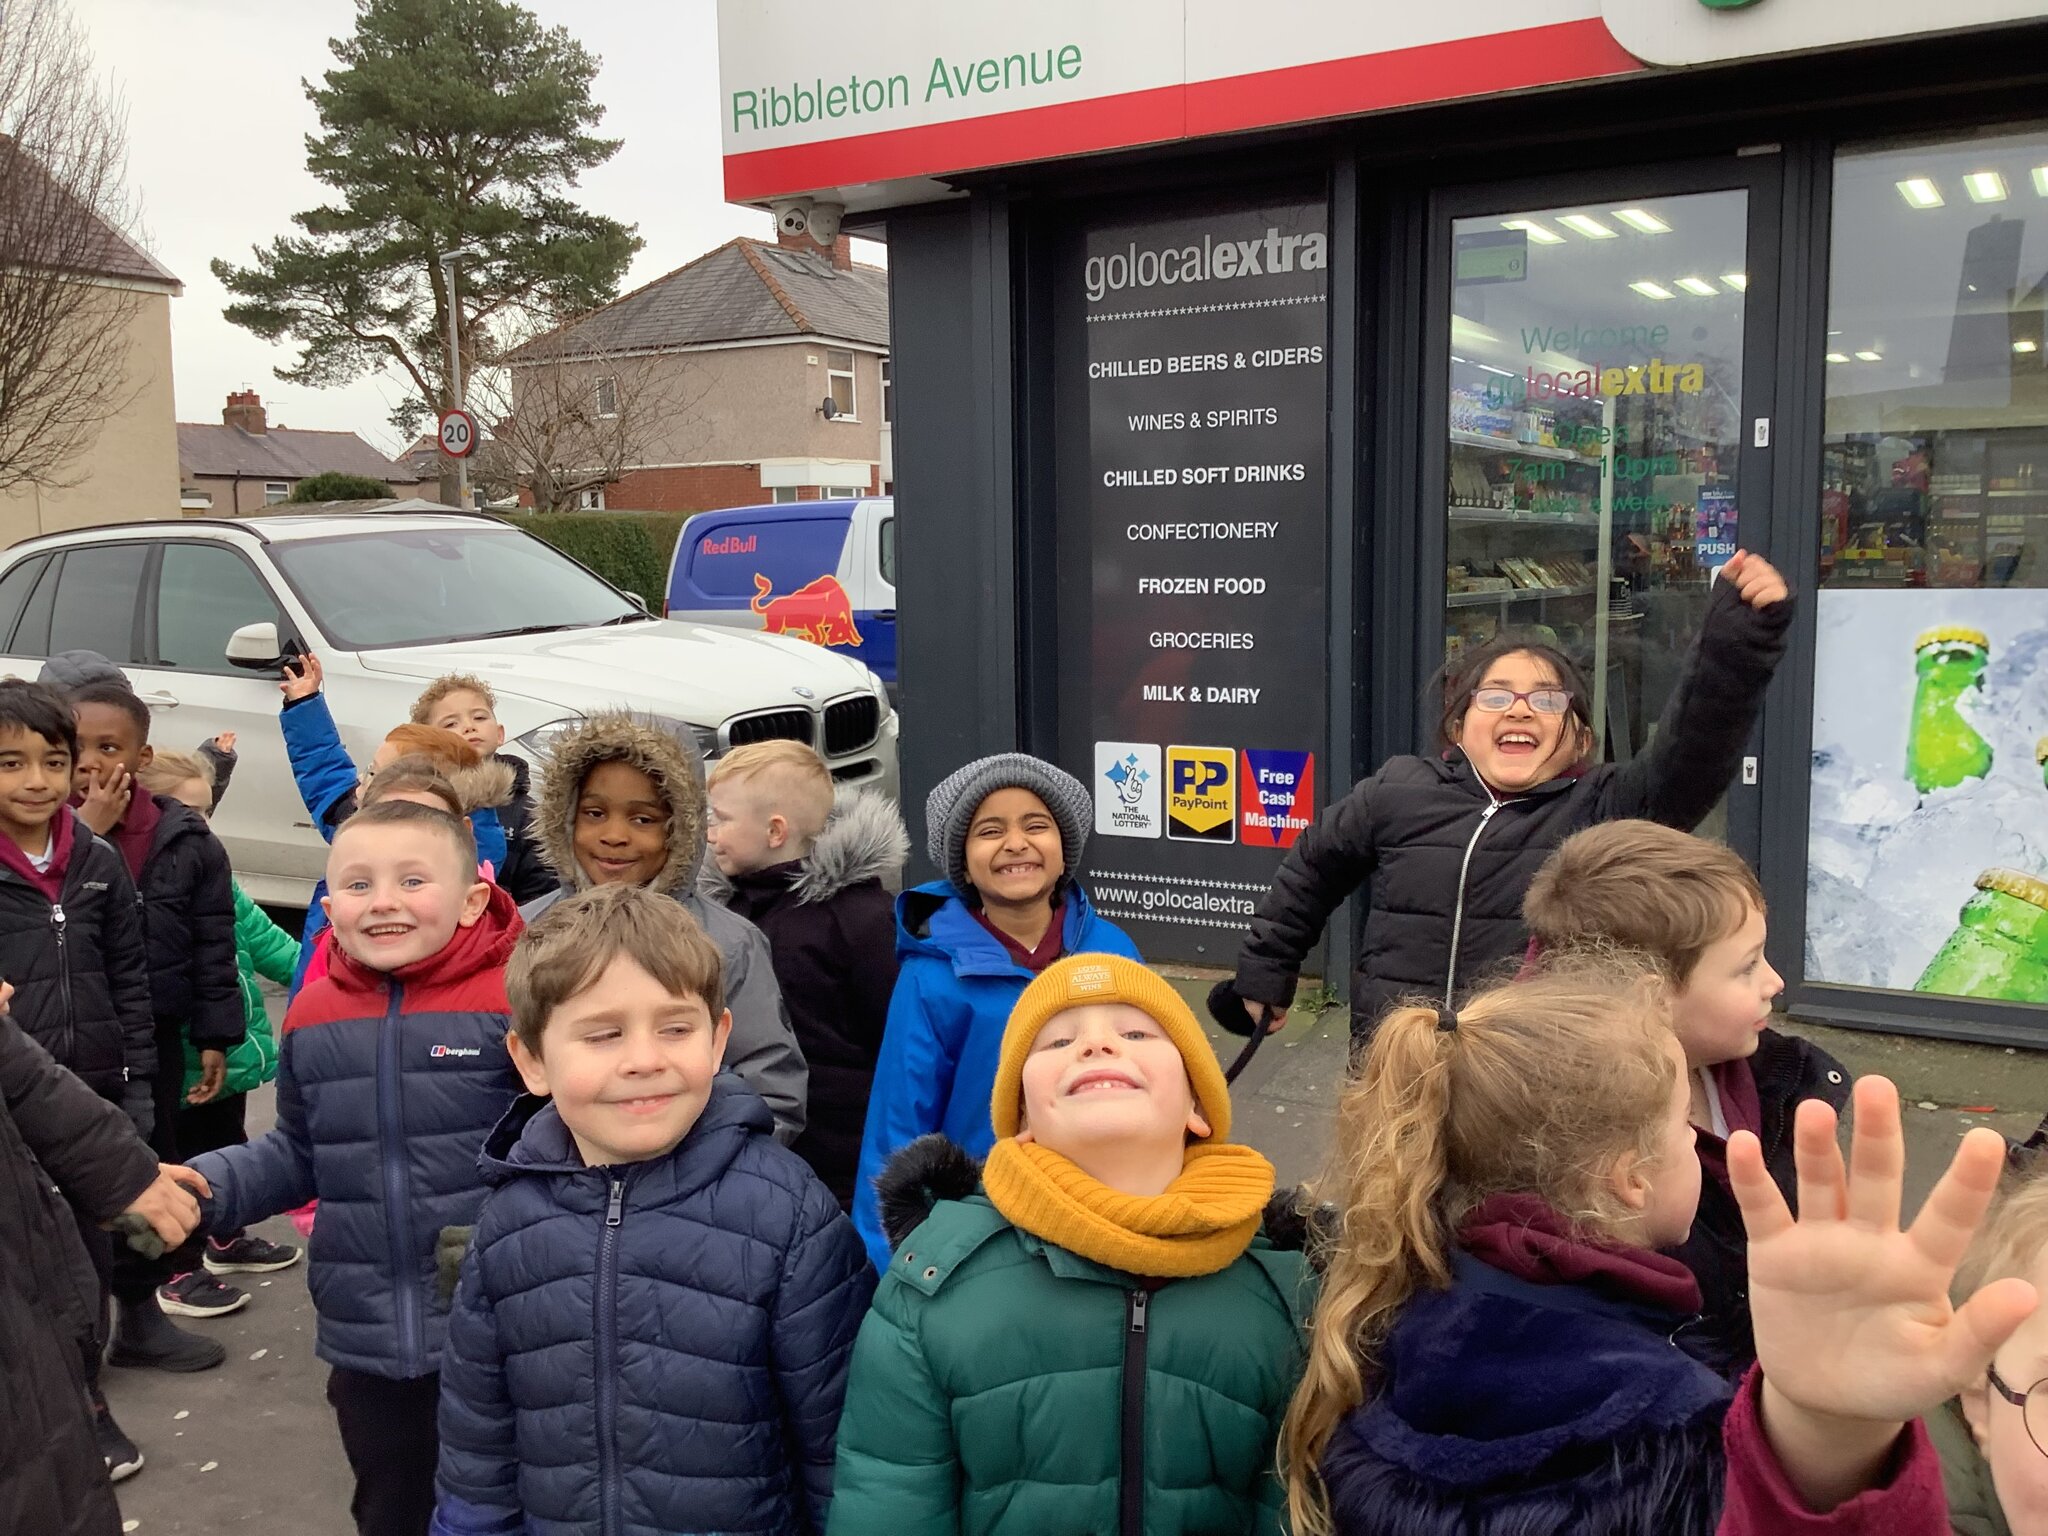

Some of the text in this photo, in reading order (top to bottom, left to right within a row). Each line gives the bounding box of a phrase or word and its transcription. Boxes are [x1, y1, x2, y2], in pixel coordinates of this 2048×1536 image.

[733, 44, 1082, 133] Ribbleton Avenue
[1085, 228, 1327, 302] golocalextra
[1521, 324, 1669, 354] Welcome
[1089, 346, 1323, 379] CHILLED BEERS & CIDERS
[1486, 358, 1704, 411] golocalextra
[1128, 407, 1277, 431] WINES & SPIRITS
[444, 424, 468, 443] 20
[1553, 421, 1629, 450] Open
[1103, 464, 1305, 487] CHILLED SOFT DRINKS
[1507, 458, 1566, 481] 7am
[1599, 453, 1677, 484] 10pm
[1127, 522, 1279, 540] CONFECTIONERY
[703, 535, 757, 555] Red Bull
[1698, 543, 1736, 555] PUSH
[1139, 578, 1266, 595] FROZEN FOOD
[1150, 632, 1254, 649] GROCERIES
[1143, 685, 1260, 704] MILK & DAIRY
[1173, 760, 1229, 796] PP
[1259, 769, 1294, 785] Free
[1173, 796, 1228, 811] PayPoint
[1258, 790, 1295, 807] Cash
[1112, 813, 1151, 822] NATIONAL
[1245, 812, 1309, 830] Machine
[1094, 886, 1255, 915] www.golocalextra
[1071, 972, 1110, 983] ALWAYS
